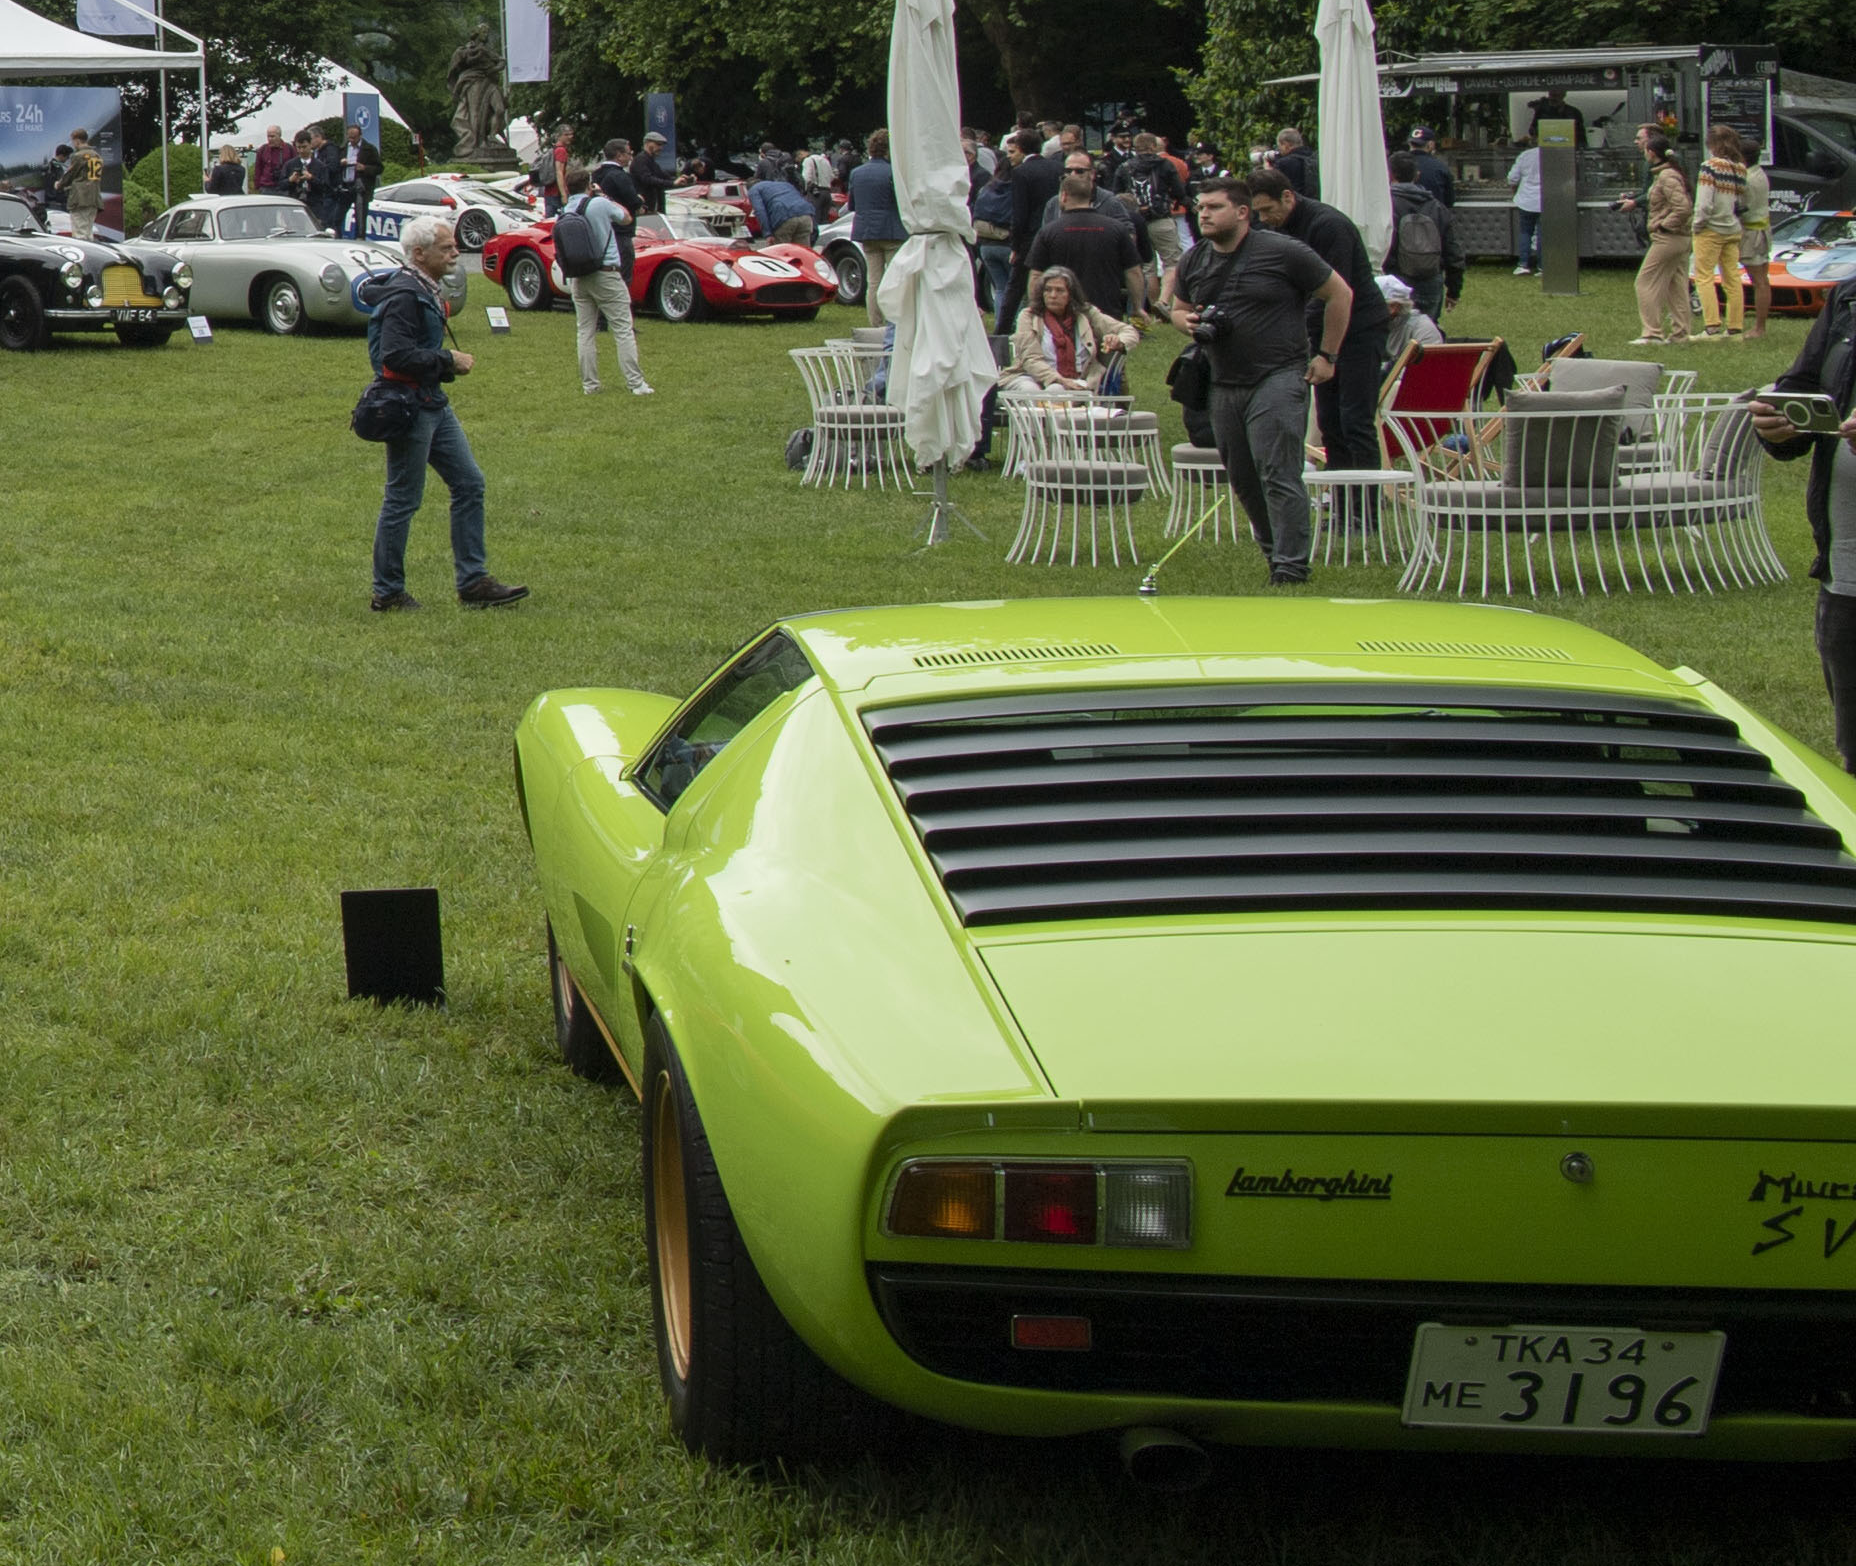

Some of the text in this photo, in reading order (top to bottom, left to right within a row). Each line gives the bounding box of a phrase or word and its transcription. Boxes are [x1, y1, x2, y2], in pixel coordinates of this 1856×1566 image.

[15, 104, 44, 123] 24h
[1748, 1169, 1856, 1204] Miur
[1491, 1334, 1647, 1366] TKA 34
[1421, 1370, 1701, 1427] ME 3196
